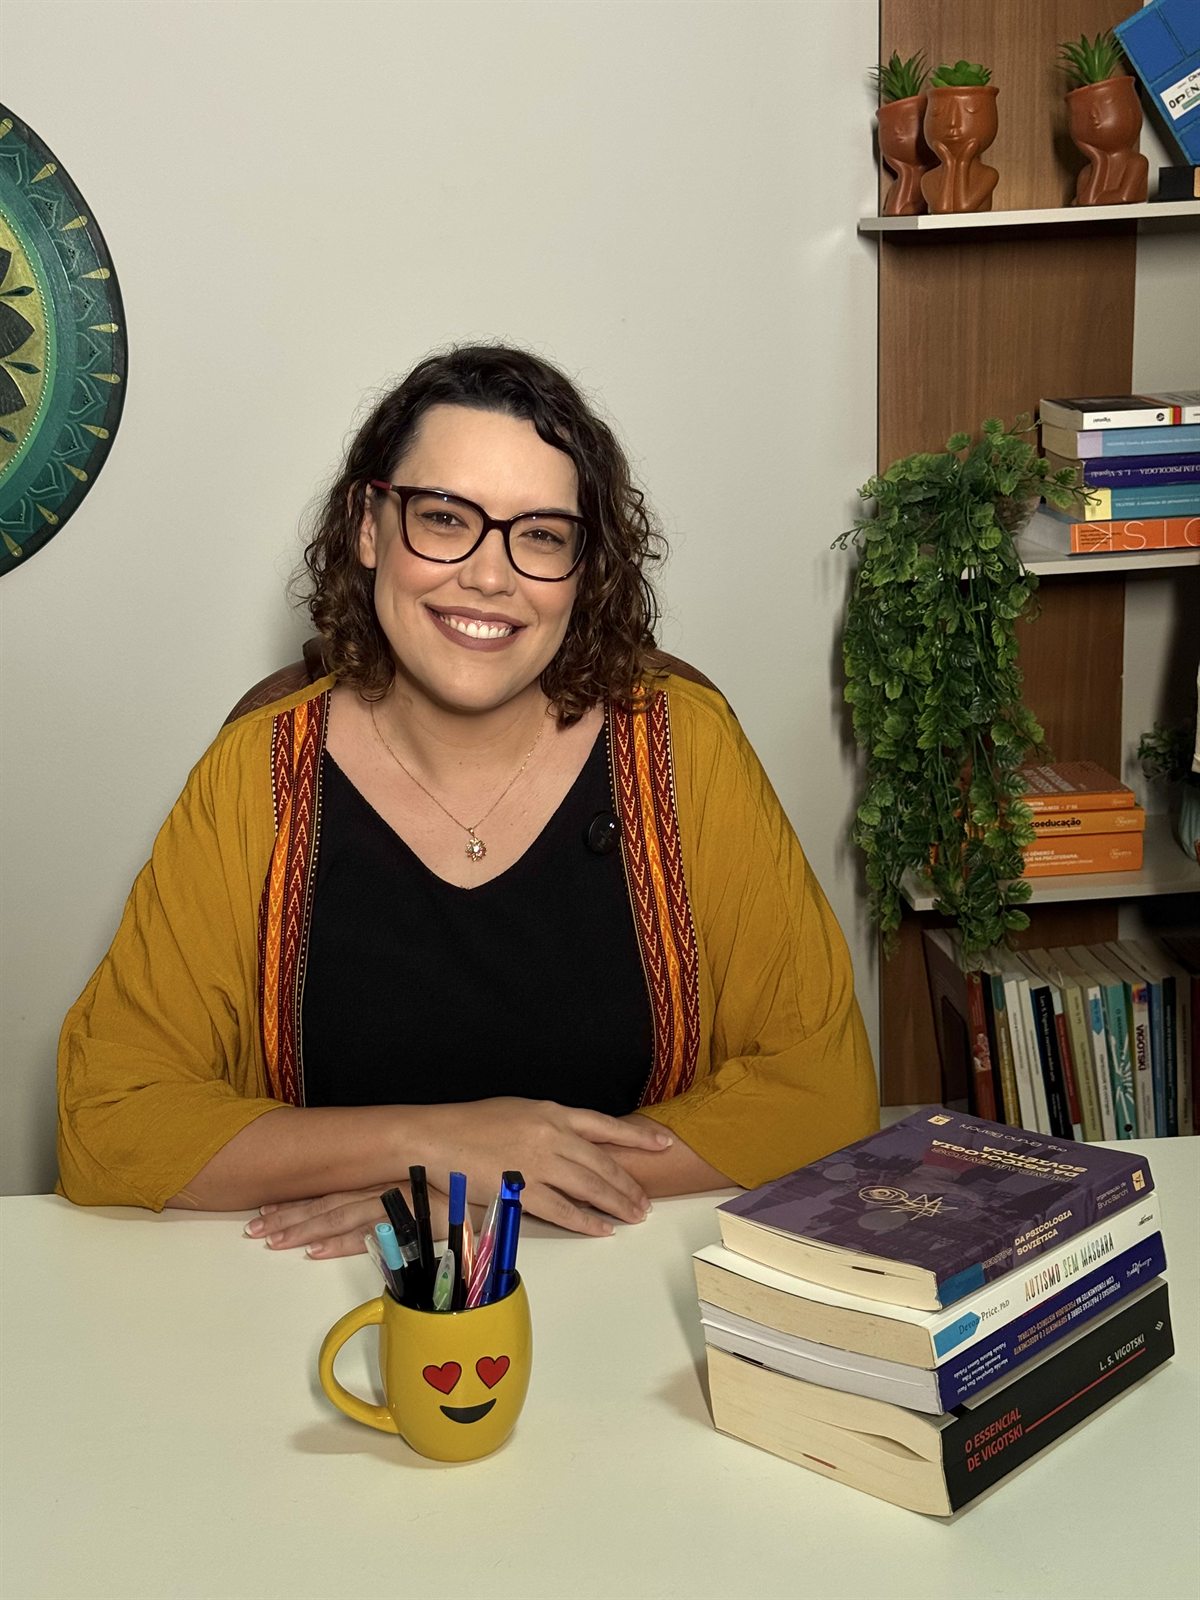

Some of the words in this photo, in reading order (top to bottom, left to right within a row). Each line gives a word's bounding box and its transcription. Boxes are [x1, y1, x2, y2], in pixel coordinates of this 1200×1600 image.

[1140, 465, 1179, 476] PSICOLOGIA
[1135, 1024, 1147, 1072] VIGOTSKI
[960, 1123, 1003, 1139] Bianchi
[1004, 1135, 1042, 1148] Bruno
[931, 1139, 1052, 1173] PSICOLOGIA
[982, 1145, 1088, 1173] SOVIÉTICA
[1053, 1169, 1080, 1178] DA
[1097, 1197, 1112, 1210] Bruno
[1111, 1189, 1129, 1205] Bianchi
[1014, 1234, 1026, 1247] DA
[1025, 1209, 1073, 1240] PSICOLOGIA
[1016, 1228, 1059, 1256] SOVIÉTICA
[1024, 1263, 1061, 1302] AUTISMO
[1062, 1255, 1080, 1279] SEM
[1081, 1232, 1115, 1268] MÁSCARA
[1081, 1280, 1107, 1302] FUNDAMENTOS
[1102, 1281, 1120, 1300] PESQUISAS
[958, 1316, 980, 1336] Devon
[999, 1299, 1010, 1312] PhD
[1099, 1360, 1107, 1372] L.
[1114, 1333, 1146, 1360] VIGOTSKI
[965, 1440, 973, 1453] O
[974, 1407, 1022, 1449] ESSENCIAL
[967, 1455, 981, 1473] DE
[981, 1424, 1024, 1463] VIGOTSKI
